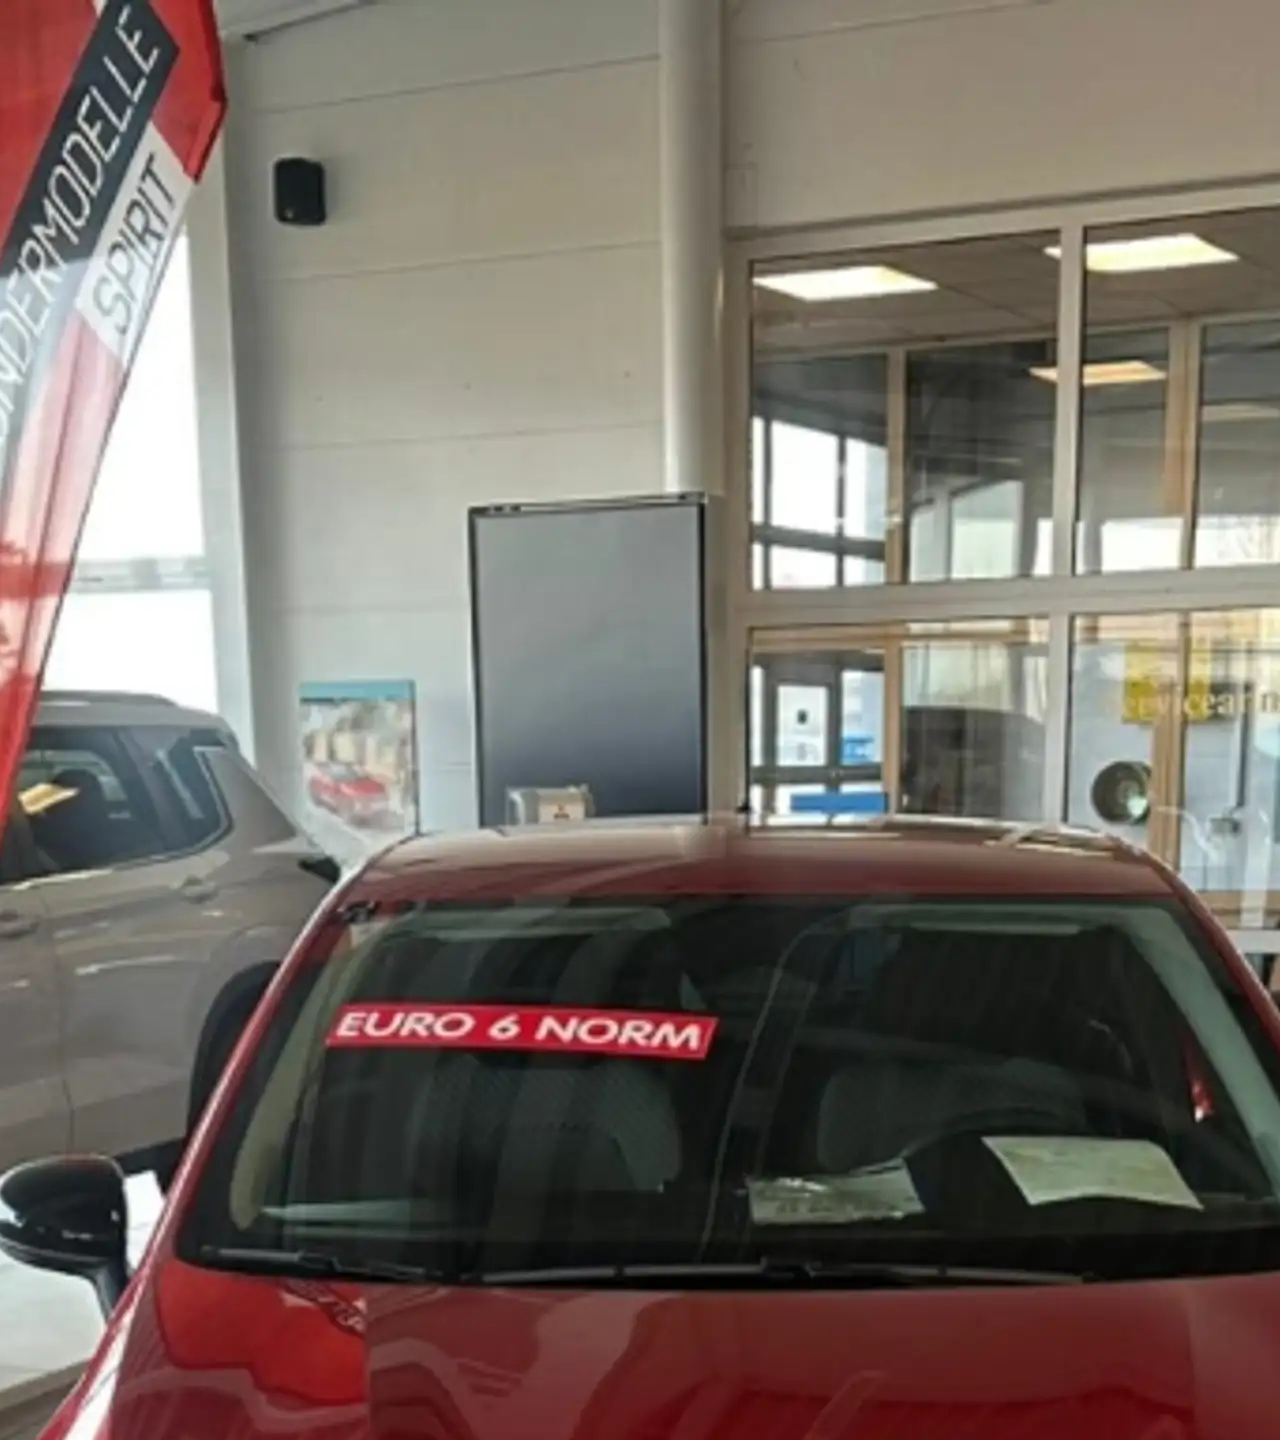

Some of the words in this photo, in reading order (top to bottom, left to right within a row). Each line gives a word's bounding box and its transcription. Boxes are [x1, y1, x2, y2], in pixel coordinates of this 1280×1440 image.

[92, 153, 175, 337] SPIRIT
[336, 1010, 476, 1039] EURO
[488, 1012, 521, 1041] 6
[534, 1015, 702, 1052] NORM
